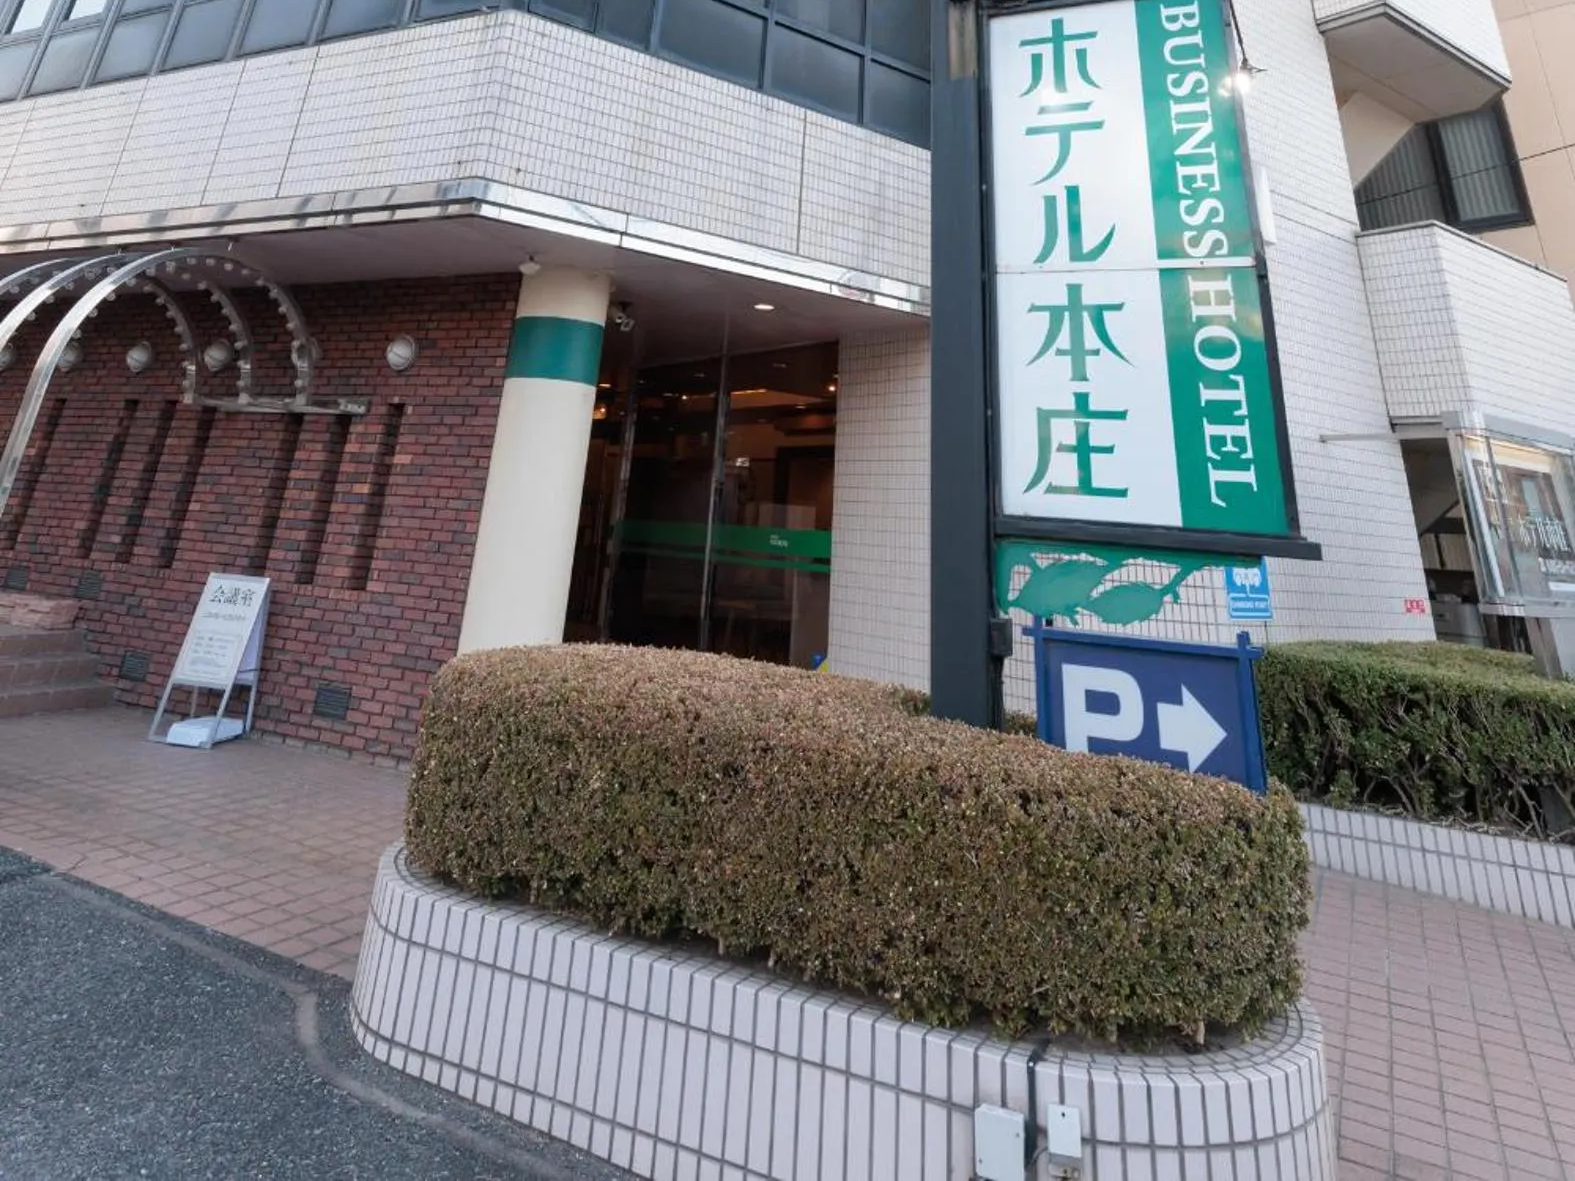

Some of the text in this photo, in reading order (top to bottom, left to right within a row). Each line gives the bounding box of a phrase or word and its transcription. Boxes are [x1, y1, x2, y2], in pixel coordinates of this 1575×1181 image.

[1018, 17, 1137, 499] ホテル本庄
[1186, 273, 1258, 507] HOTEL
[1061, 663, 1144, 754] P
